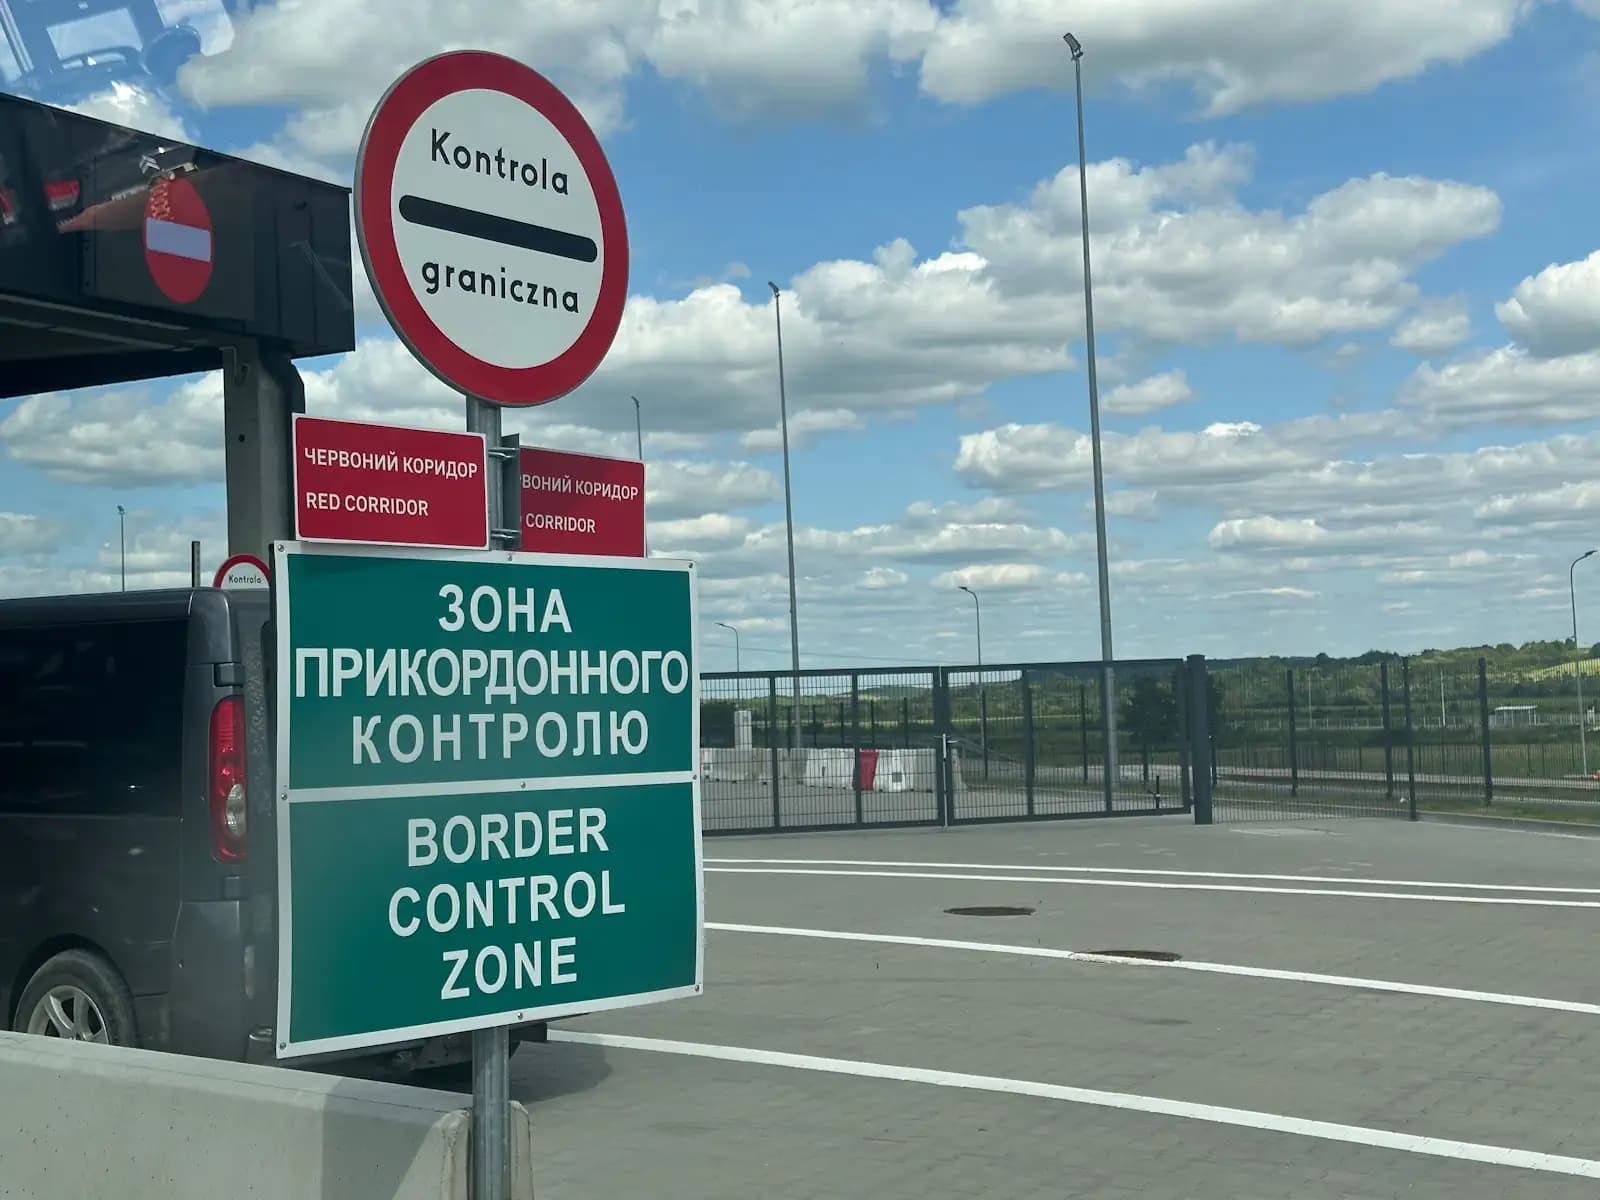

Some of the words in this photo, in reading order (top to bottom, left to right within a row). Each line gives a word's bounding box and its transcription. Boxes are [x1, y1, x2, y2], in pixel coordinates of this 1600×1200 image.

[431, 127, 569, 196] Kontrola
[421, 261, 580, 314] graniczna
[304, 447, 399, 472] ЧЕРВОНИЙ
[403, 456, 478, 480] КОРИДОР
[520, 473, 572, 494] ВОНИЙ
[575, 479, 639, 502] КОРИДОР
[306, 491, 341, 511] RED
[344, 494, 429, 517] CORRIDOR
[525, 512, 596, 534] CORRIDOR
[228, 575, 262, 584] Kontrola
[438, 583, 572, 633] ЗОНА
[295, 647, 689, 705] ПРИКОРДОННОГО
[352, 710, 649, 765] КОНТРОЛЮ
[408, 807, 609, 867] BORDER
[388, 870, 626, 937] CONTROL
[441, 936, 577, 1000] ZONE
